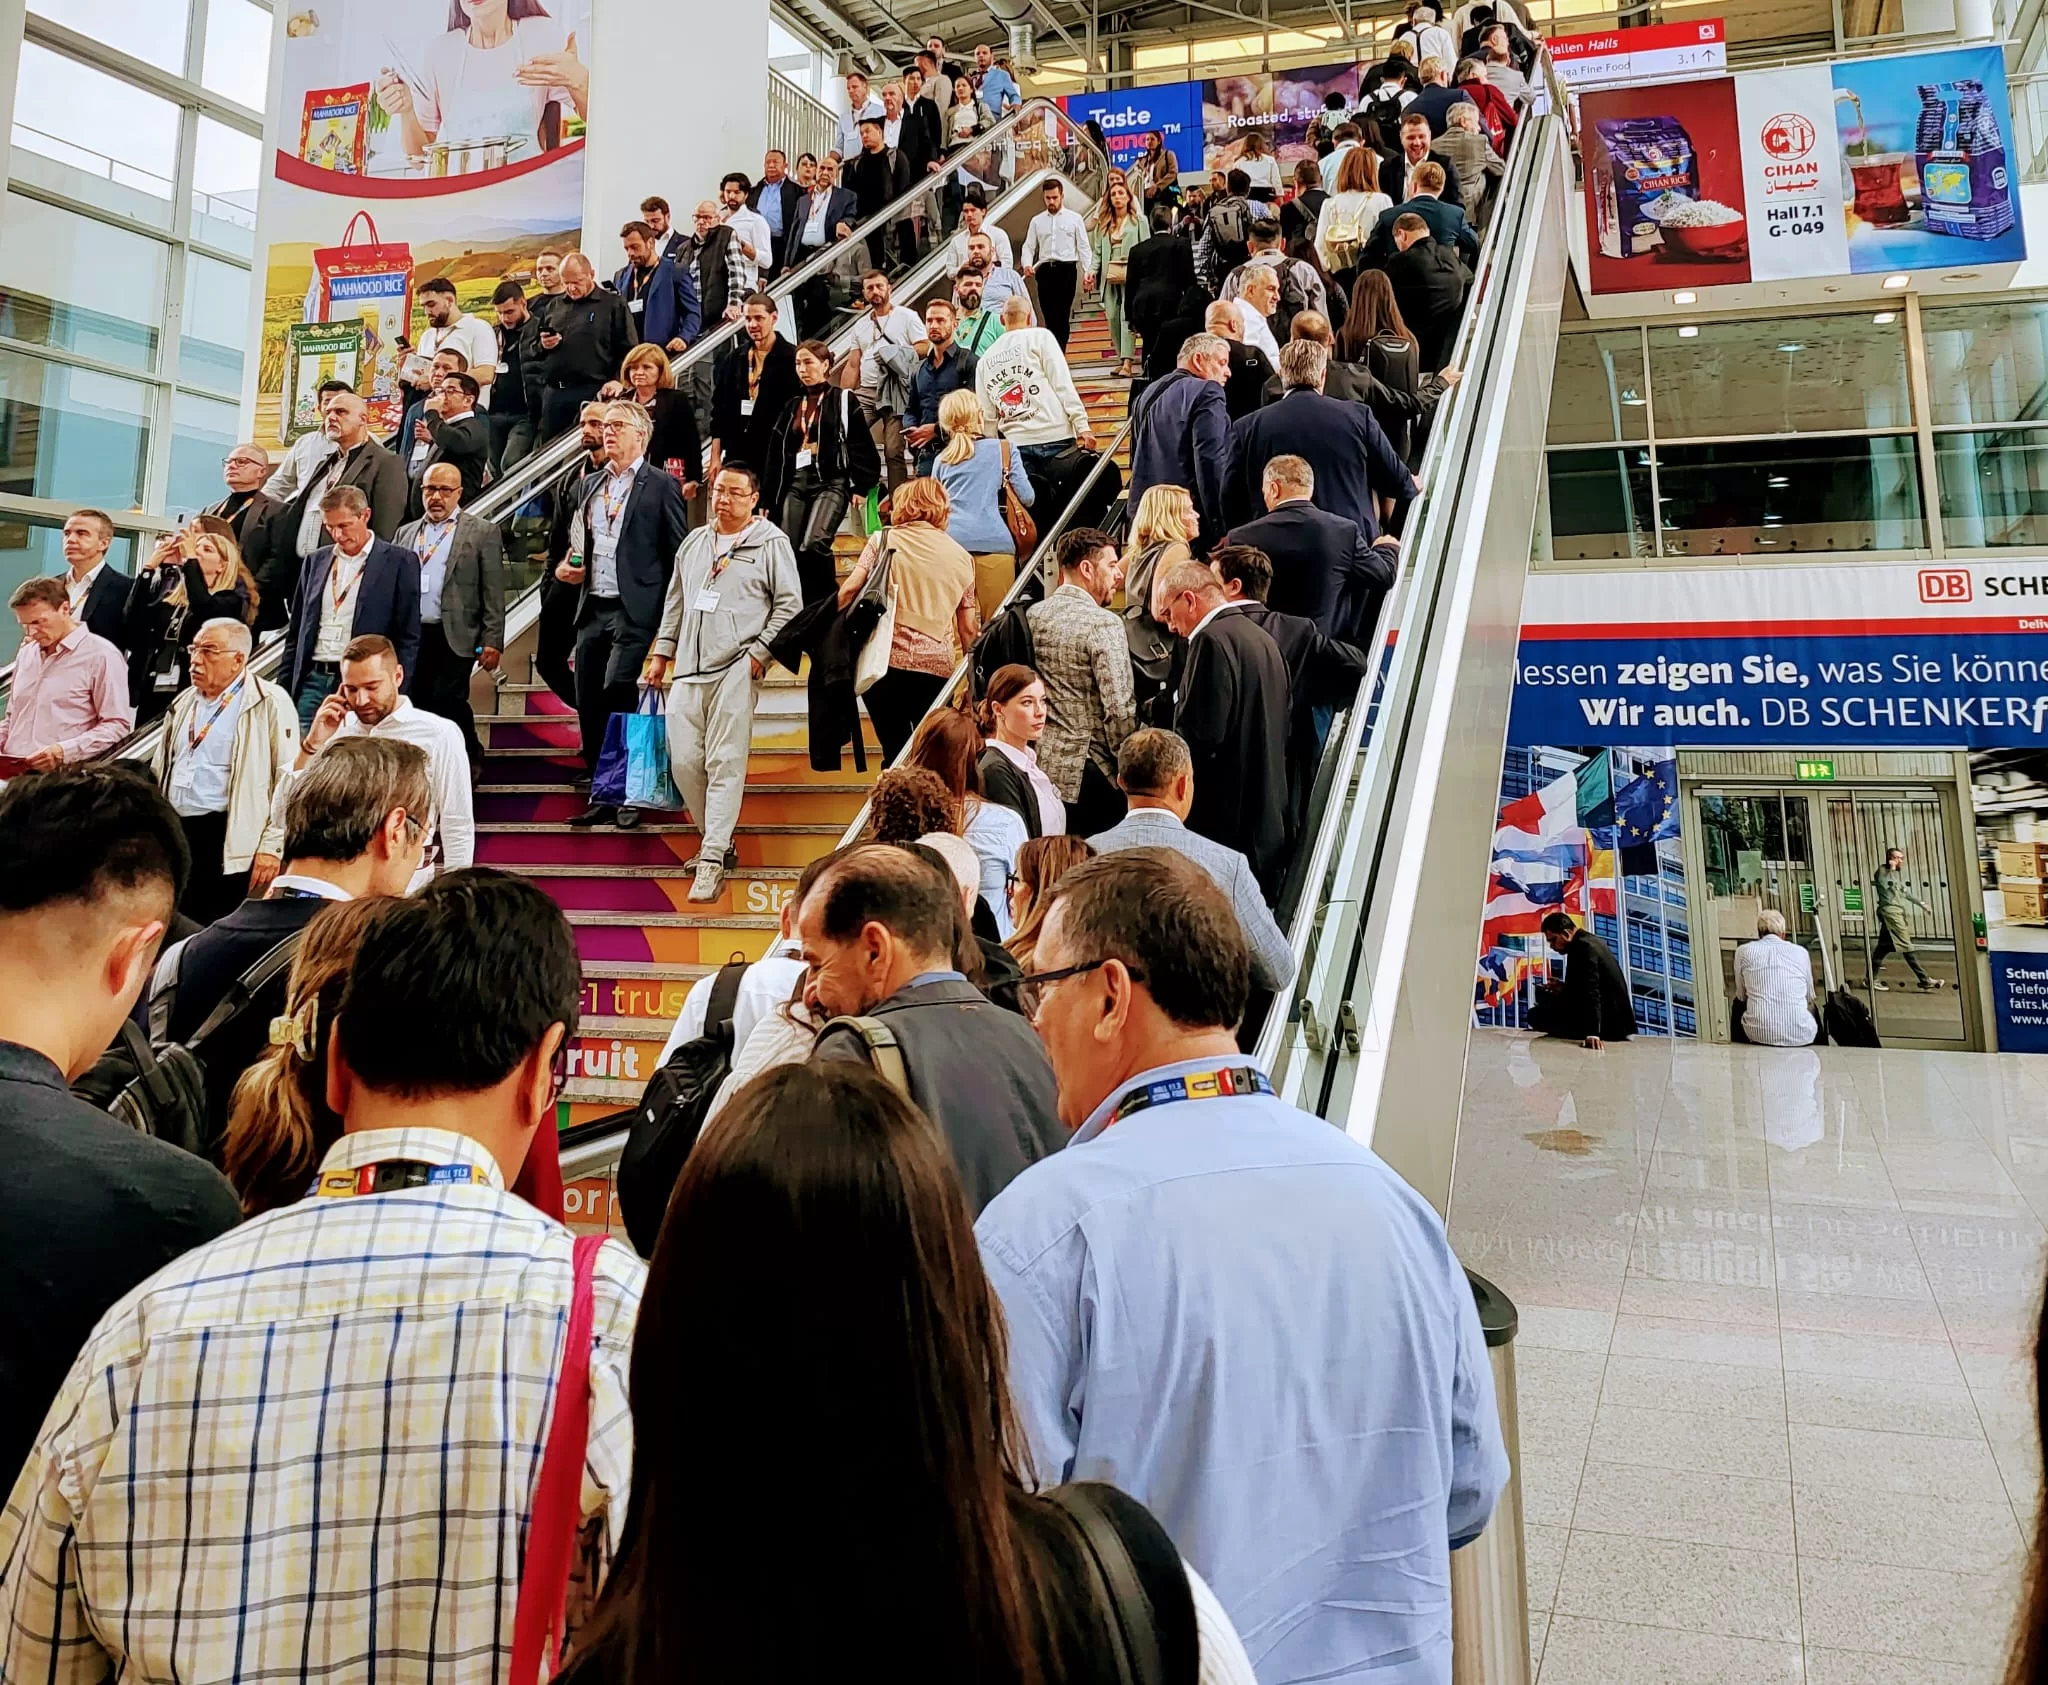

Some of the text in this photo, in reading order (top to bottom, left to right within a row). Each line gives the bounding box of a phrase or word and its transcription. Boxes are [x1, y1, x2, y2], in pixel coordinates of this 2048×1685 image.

[1588, 37, 1619, 52] Halls
[1678, 53, 1696, 65] 3.1
[1581, 63, 1603, 75] Fine
[1606, 60, 1631, 72] Food
[344, 104, 357, 115] RICE
[1089, 106, 1152, 130] Taste
[1228, 108, 1292, 128] Roasted,
[1163, 123, 1181, 135] TM
[1764, 162, 1819, 177] CIHAN
[1643, 175, 1688, 190] CIHAN RICE
[1767, 204, 1824, 221] Hall 7.1
[1792, 221, 1825, 236] 049
[332, 278, 403, 297] MAHMOOD RICE
[302, 340, 354, 354] MAHMOOD RICE
[1925, 575, 1966, 598] DB
[1617, 656, 1733, 691] zeigen
[1742, 654, 1810, 689] Sie,
[1817, 660, 1884, 683] was
[1892, 653, 1942, 683] Sie
[1579, 697, 1645, 727] Wir
[1653, 697, 1751, 727] auch.
[1761, 697, 1810, 727] DB
